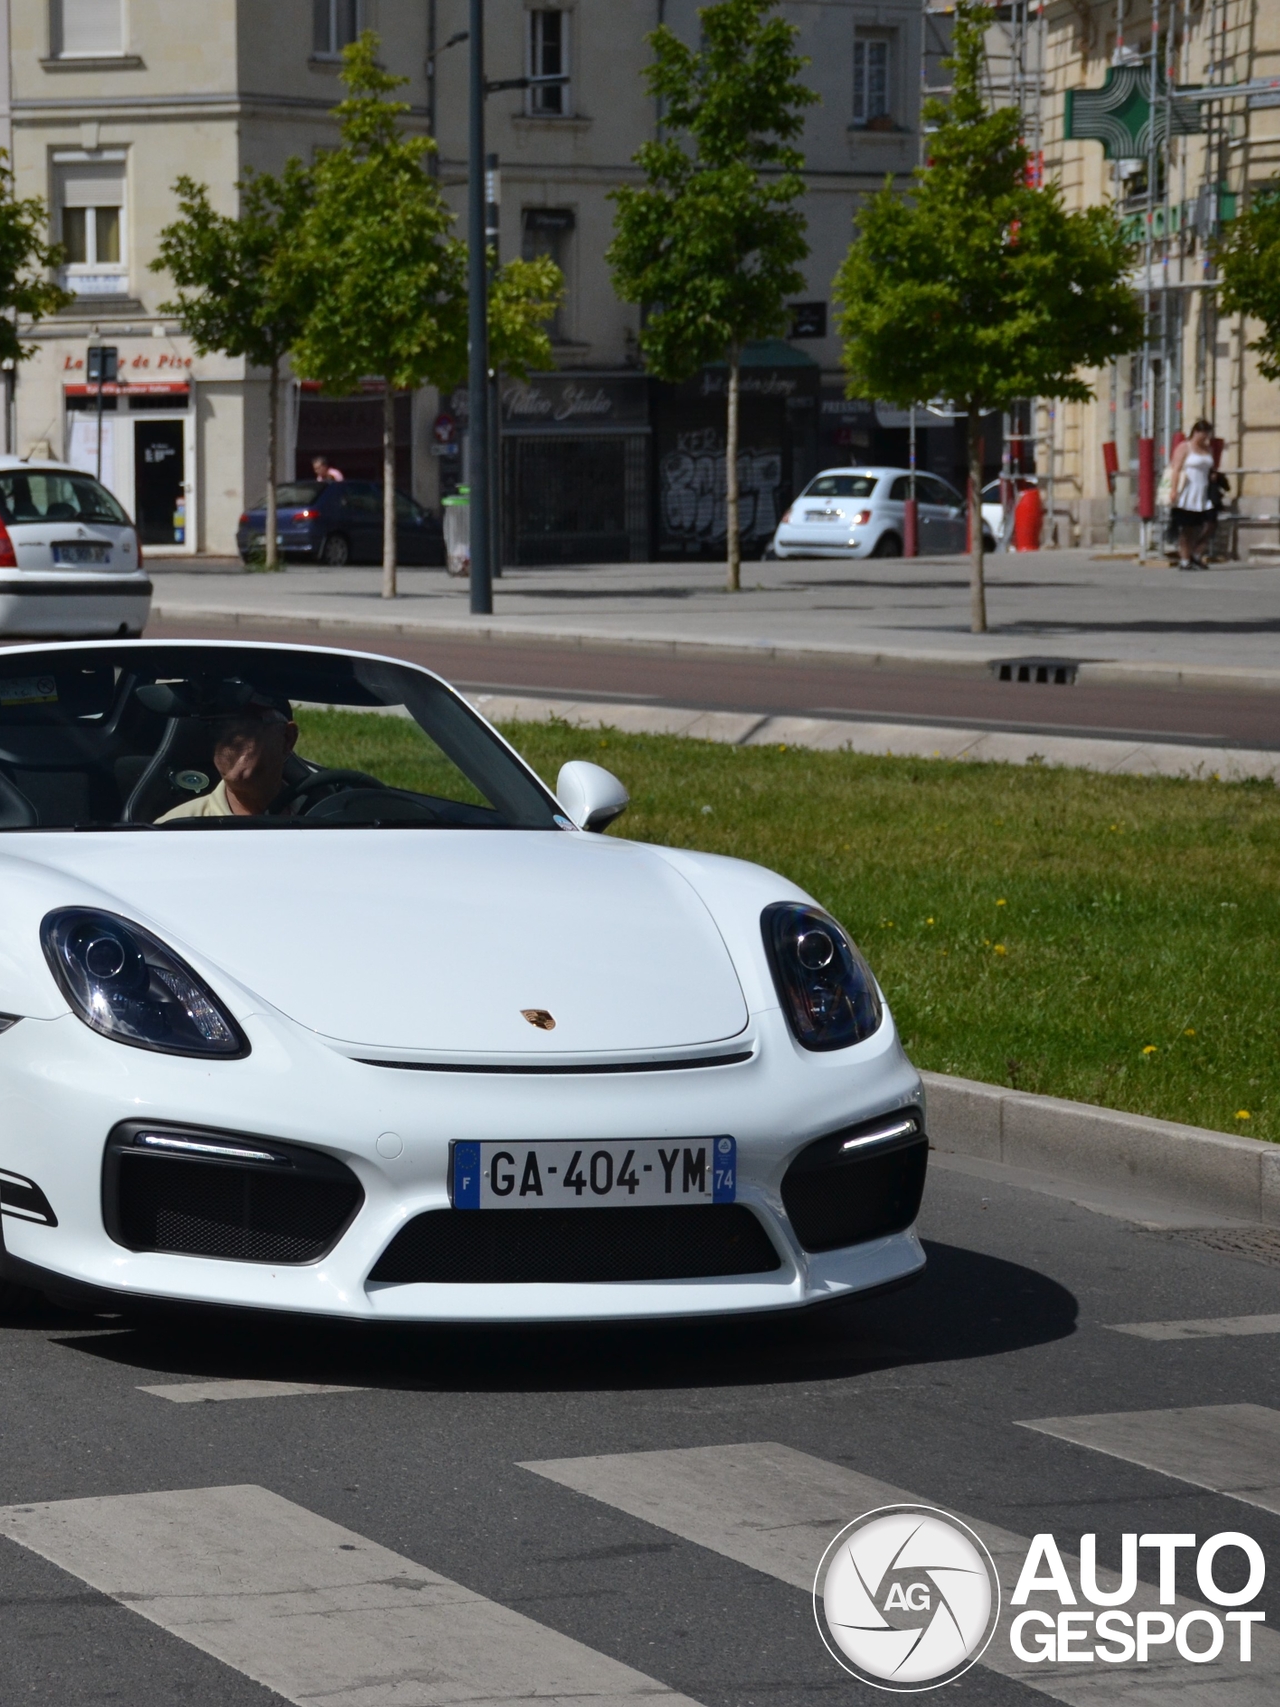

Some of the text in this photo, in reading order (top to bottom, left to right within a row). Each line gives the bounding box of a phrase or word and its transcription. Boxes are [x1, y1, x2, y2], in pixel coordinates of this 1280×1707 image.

[64, 356, 83, 370] La
[132, 355, 148, 368] de
[462, 1177, 471, 1190] F
[490, 1147, 707, 1197] GA-404-YM
[716, 1169, 734, 1190] 74
